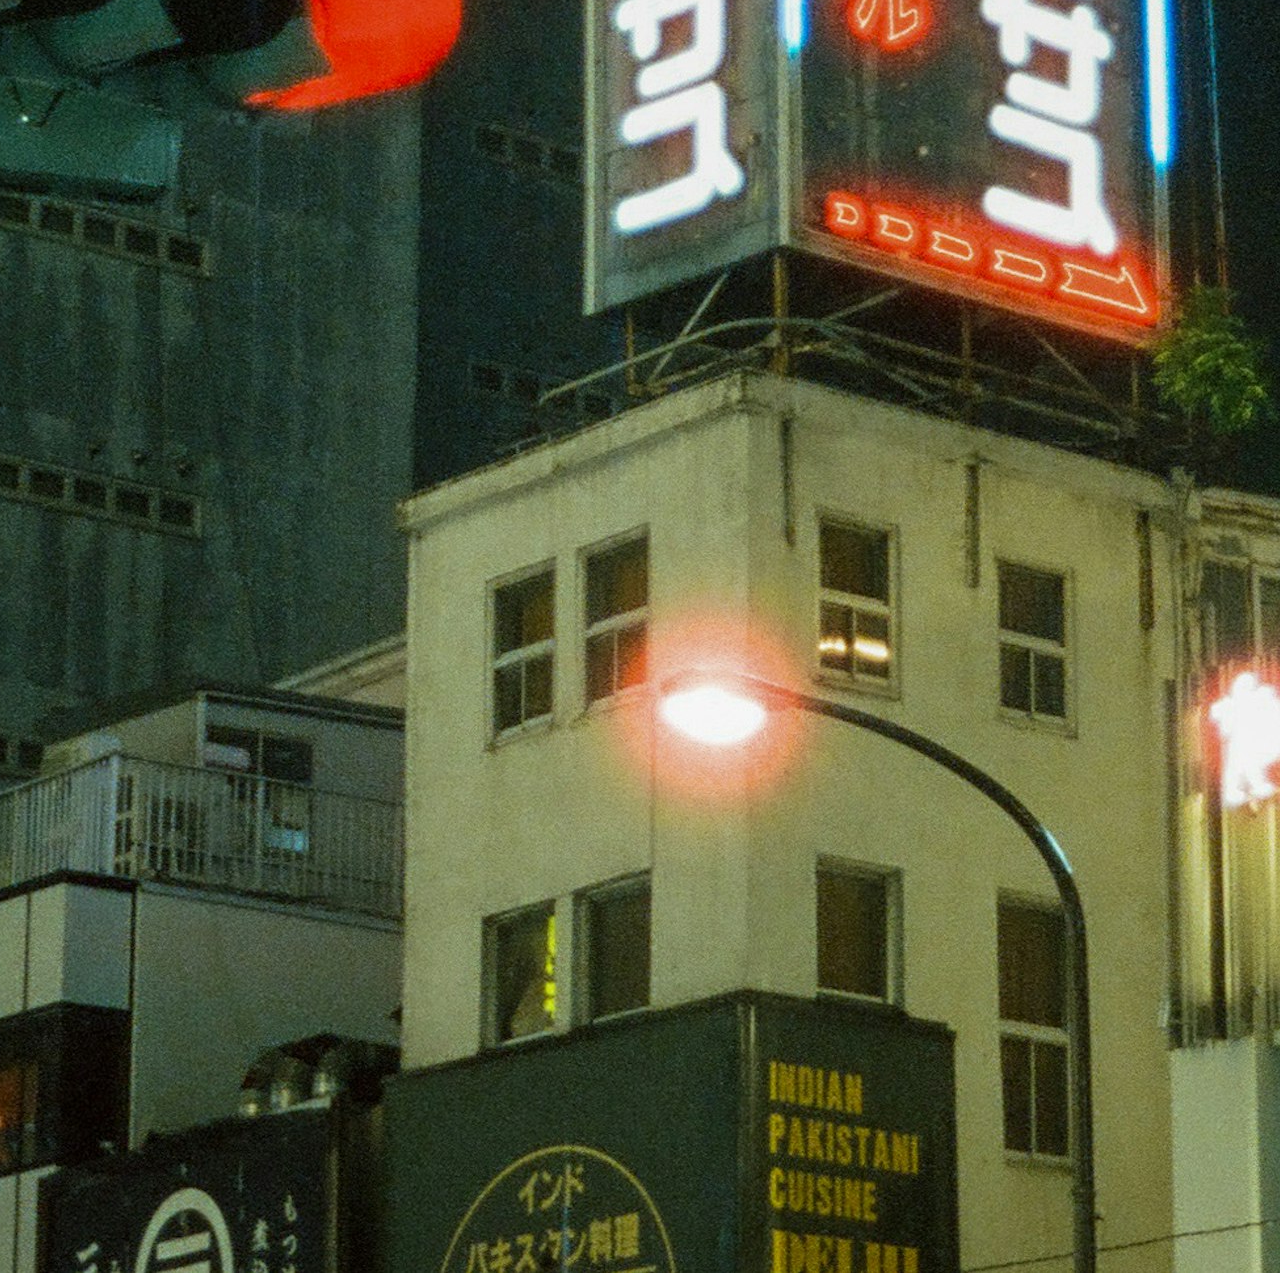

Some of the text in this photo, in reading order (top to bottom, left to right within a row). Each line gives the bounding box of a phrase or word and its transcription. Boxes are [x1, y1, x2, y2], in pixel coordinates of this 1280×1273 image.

[769, 1060, 863, 1115] INDIAN
[769, 1113, 919, 1174] PAKISTANI
[517, 1164, 585, 1215] インド
[769, 1167, 878, 1222] CUISINE
[465, 1212, 640, 1273] パキスタン料理
